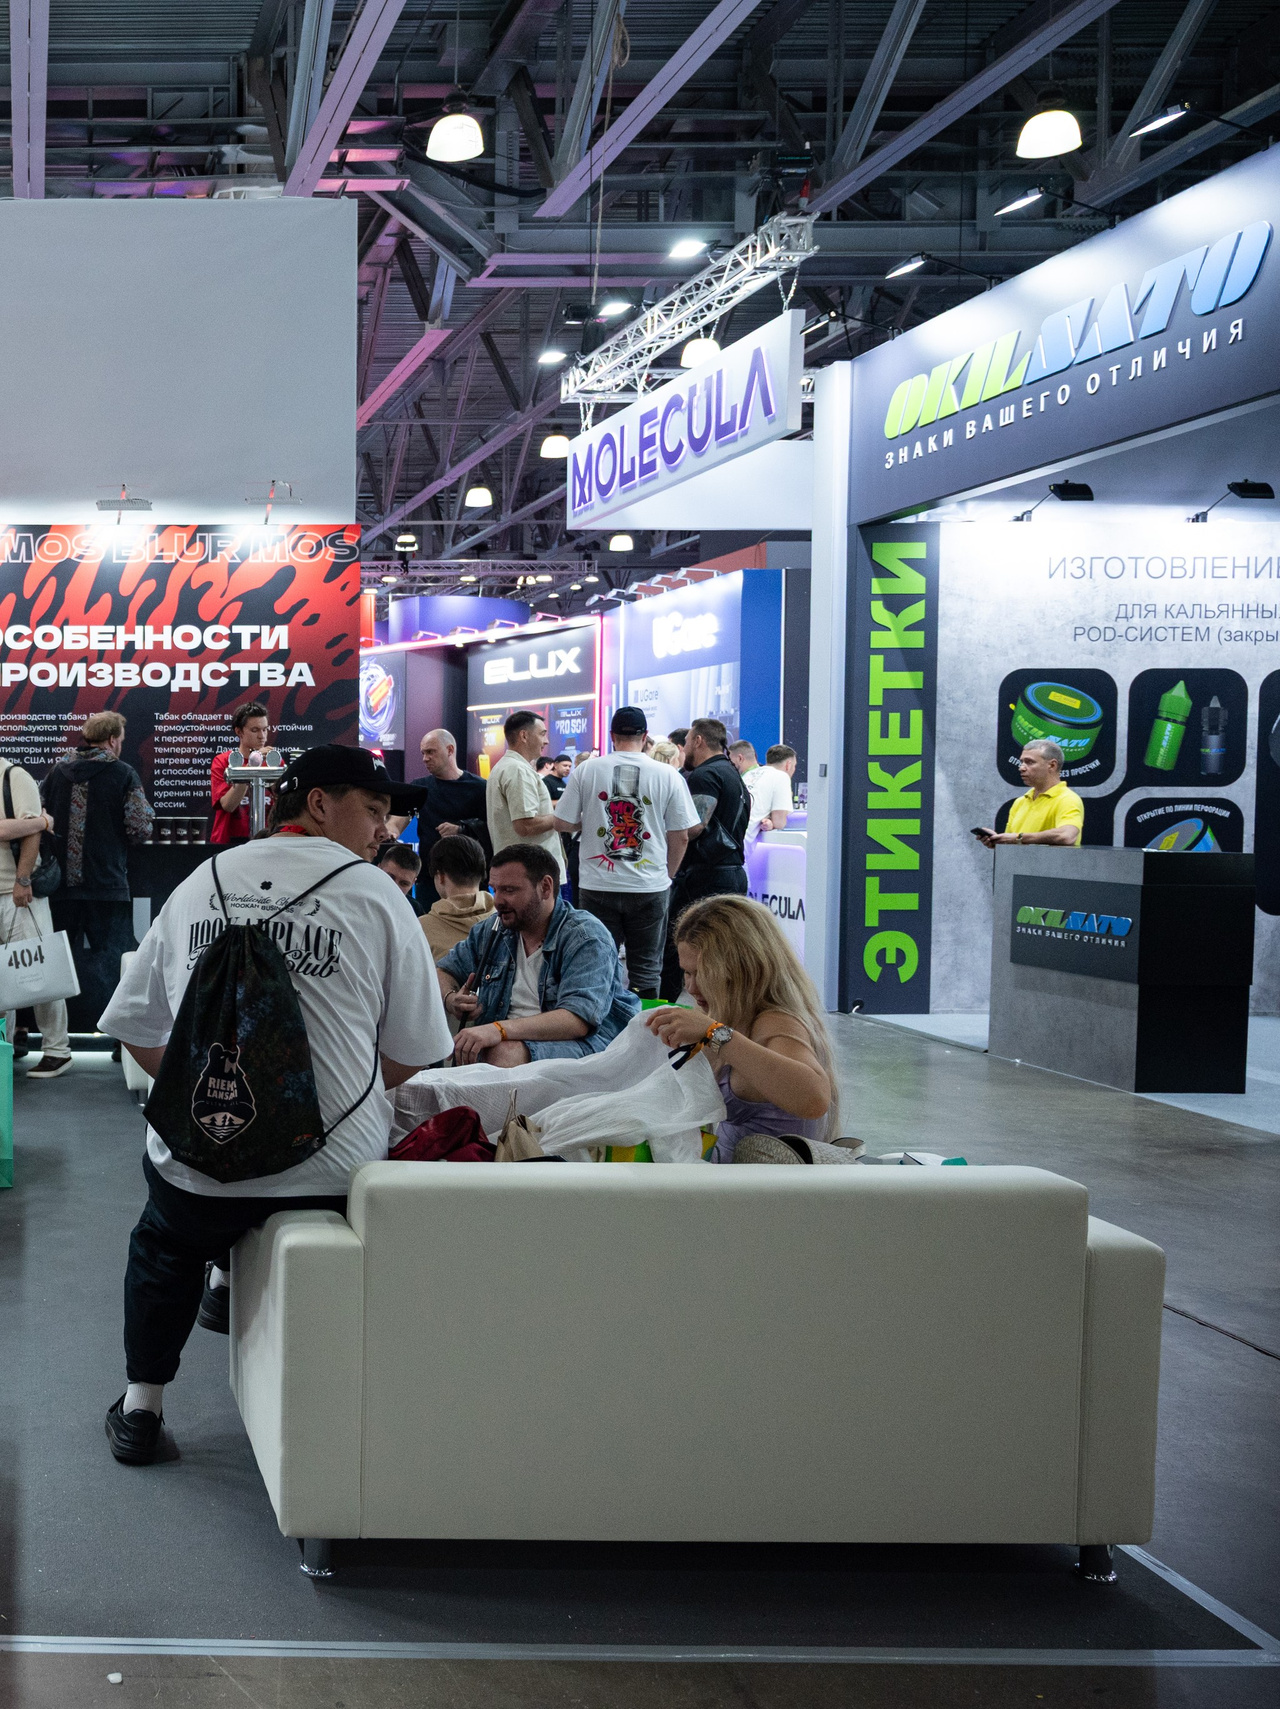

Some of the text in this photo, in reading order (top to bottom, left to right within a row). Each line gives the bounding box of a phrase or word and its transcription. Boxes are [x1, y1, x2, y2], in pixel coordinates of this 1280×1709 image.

[885, 318, 1245, 469] ЗНАКИ ВАШЕГО ОТЛИЧИЯ
[572, 346, 775, 512] MOLECULA
[113, 533, 241, 563] BLUR
[249, 533, 360, 563] MOS
[1115, 603, 1280, 622] ДЛЯ КАЛЬЯННЫ
[1073, 626, 1210, 642] POD-СИСТЕМ
[484, 646, 581, 685] ELUX
[58, 712, 88, 720] табака
[154, 712, 180, 720] Табак
[181, 712, 223, 721] обладает
[154, 724, 232, 733] термоустойчивос
[272, 723, 313, 732] устойчив
[161, 735, 208, 744] перегреву
[217, 735, 240, 744] пере
[154, 746, 214, 755] температуры.
[24, 756, 46, 764] США
[154, 757, 190, 765] нагреве
[863, 542, 927, 984] ЭТИКЕТКИ
[1070, 759, 1101, 776] ПРОСЕЧКИ
[161, 767, 205, 775] способен
[154, 790, 191, 798] курения
[1136, 806, 1165, 823] ОТКРЫТИЕ
[1165, 805, 1174, 813] ПО
[1193, 804, 1231, 818] ПЕРФОРАЦИИ
[1016, 926, 1126, 948] ЗНАКИ ВАШЕГО ОТЛИЧИЯ
[8, 945, 45, 969] 404
